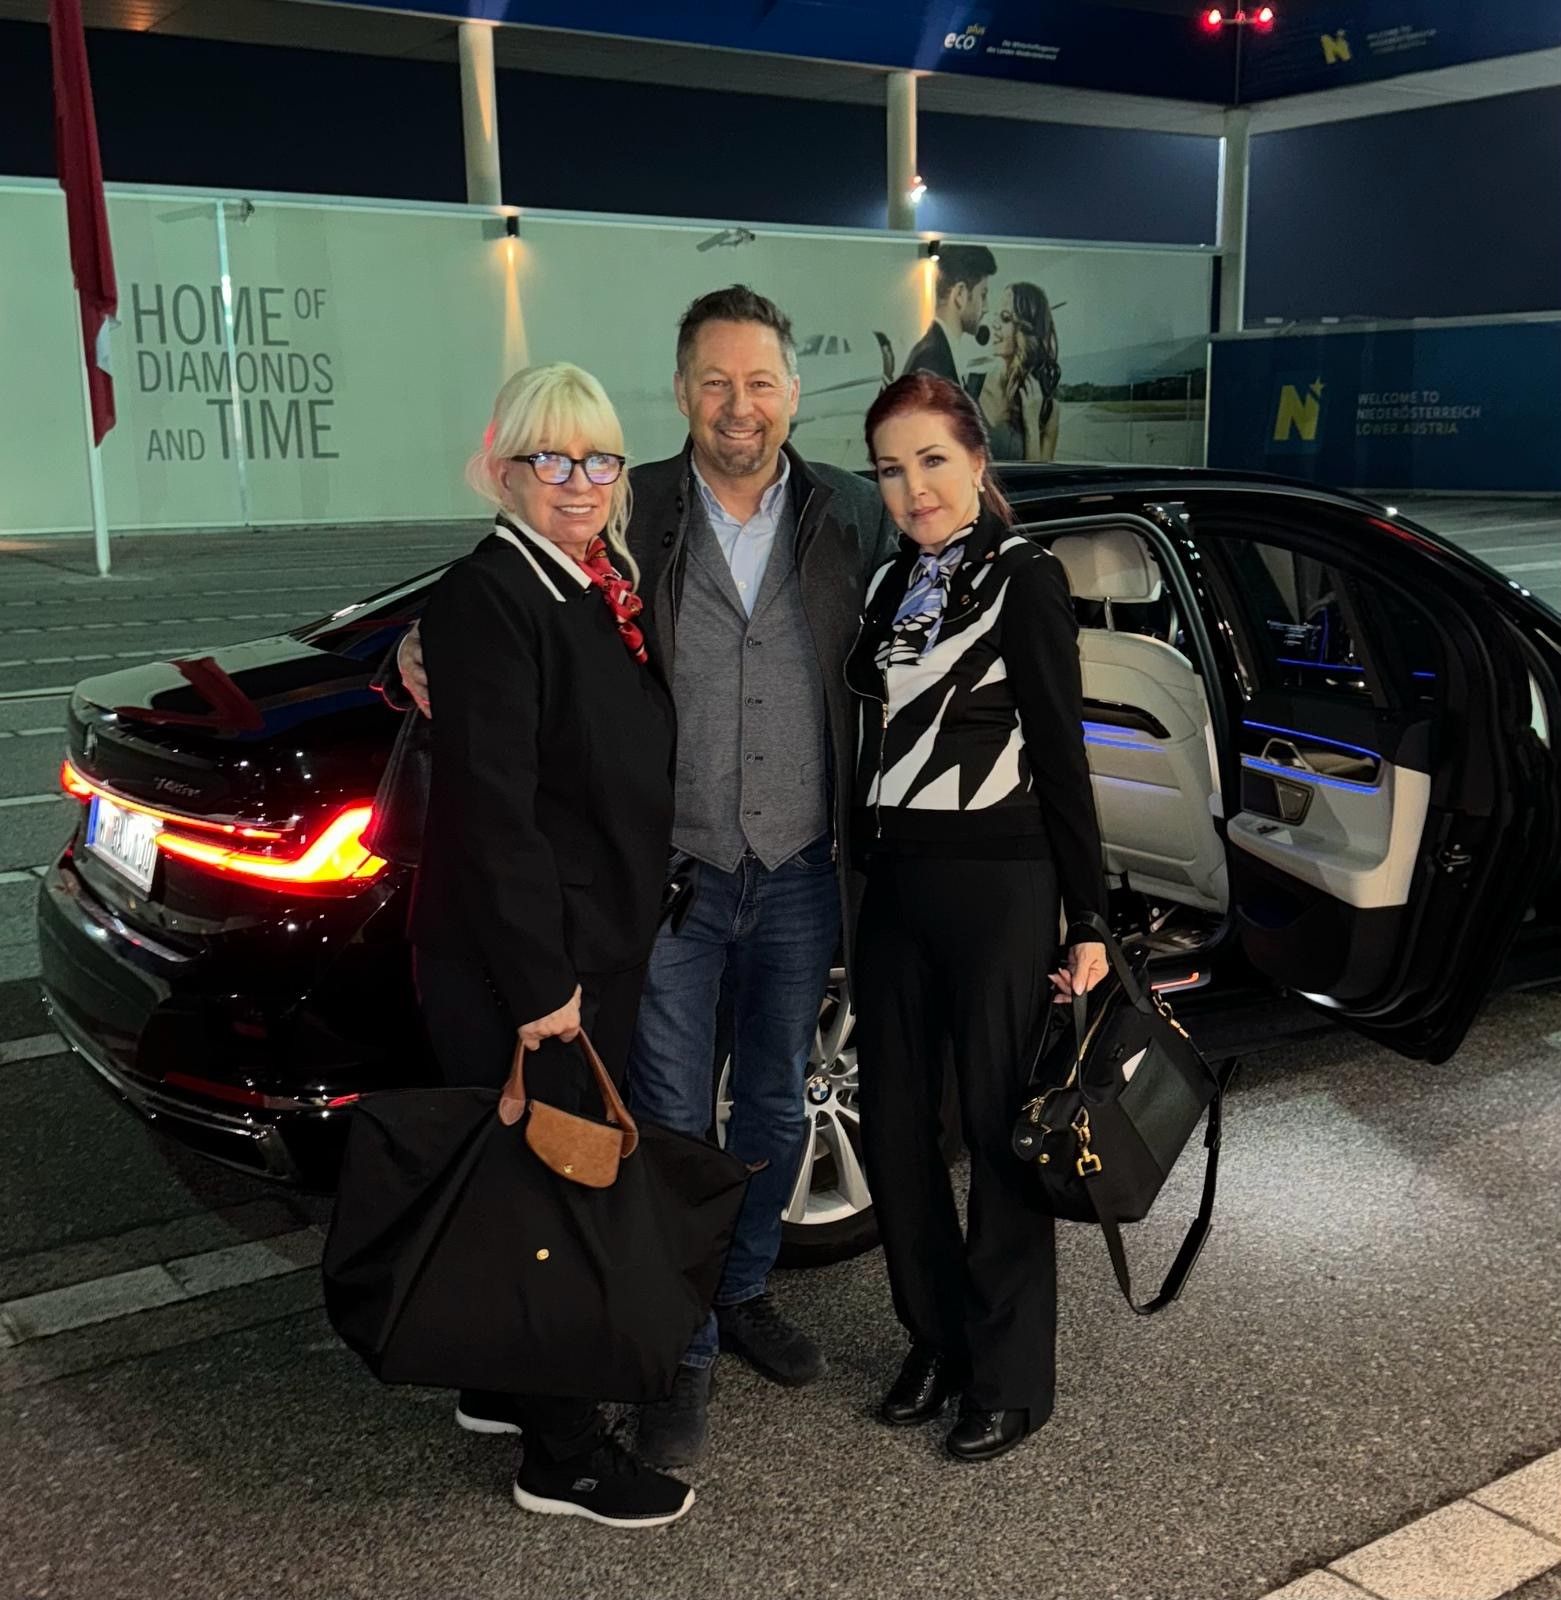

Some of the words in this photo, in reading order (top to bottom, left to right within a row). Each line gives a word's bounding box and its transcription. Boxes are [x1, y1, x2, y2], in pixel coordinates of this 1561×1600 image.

[944, 32, 976, 51] eco
[131, 283, 290, 346] HOME
[294, 287, 327, 319] OF
[137, 350, 334, 394] DIAMONDS
[1273, 384, 1321, 441] N
[1356, 405, 1482, 420] NIEDERÖSTERREICH
[1357, 391, 1418, 405] WELCOME
[1422, 390, 1441, 404] TO
[147, 429, 206, 461] AND
[206, 399, 340, 460] TIME
[1356, 422, 1399, 436] LOWER
[1402, 421, 1459, 435] AUSTRIA
